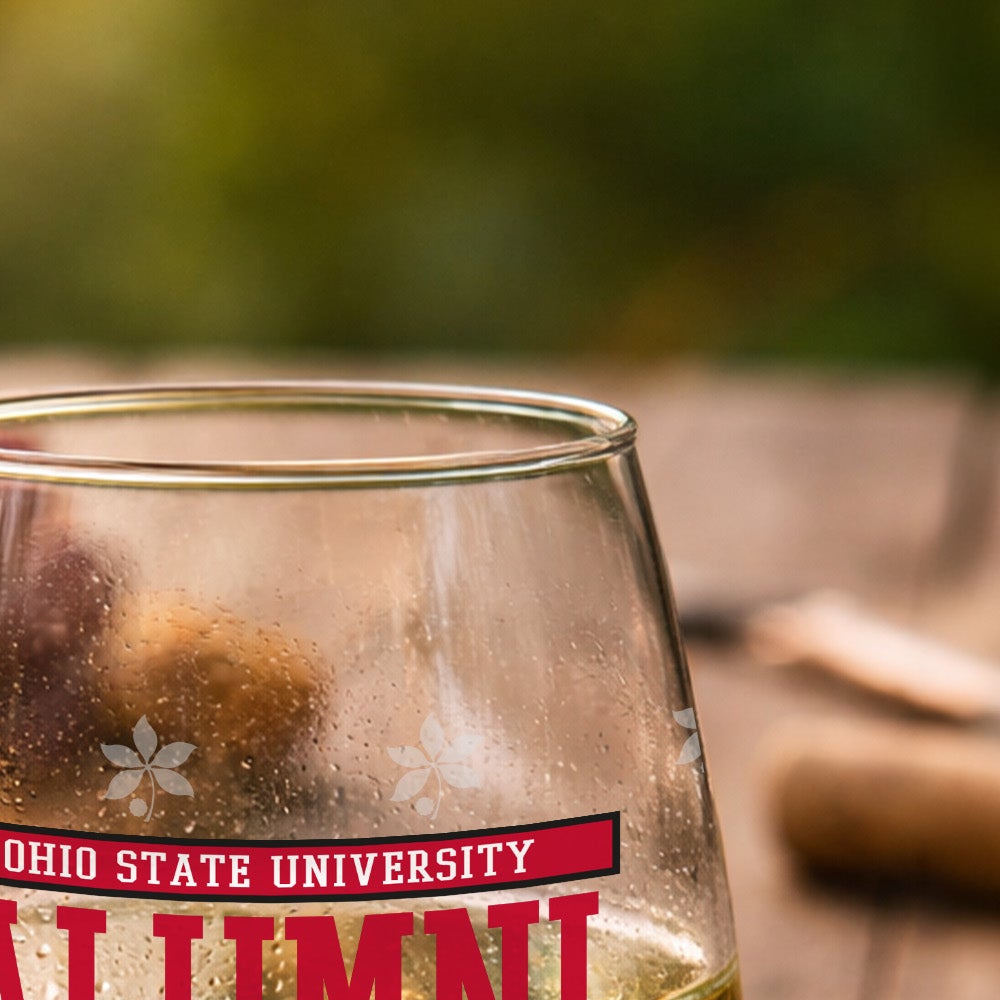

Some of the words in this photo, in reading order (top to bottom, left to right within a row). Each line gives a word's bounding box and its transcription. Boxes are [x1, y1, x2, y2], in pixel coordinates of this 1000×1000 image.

[3, 838, 98, 881] OHIO
[116, 849, 251, 889] STATE
[271, 838, 535, 889] UNIVERSITY
